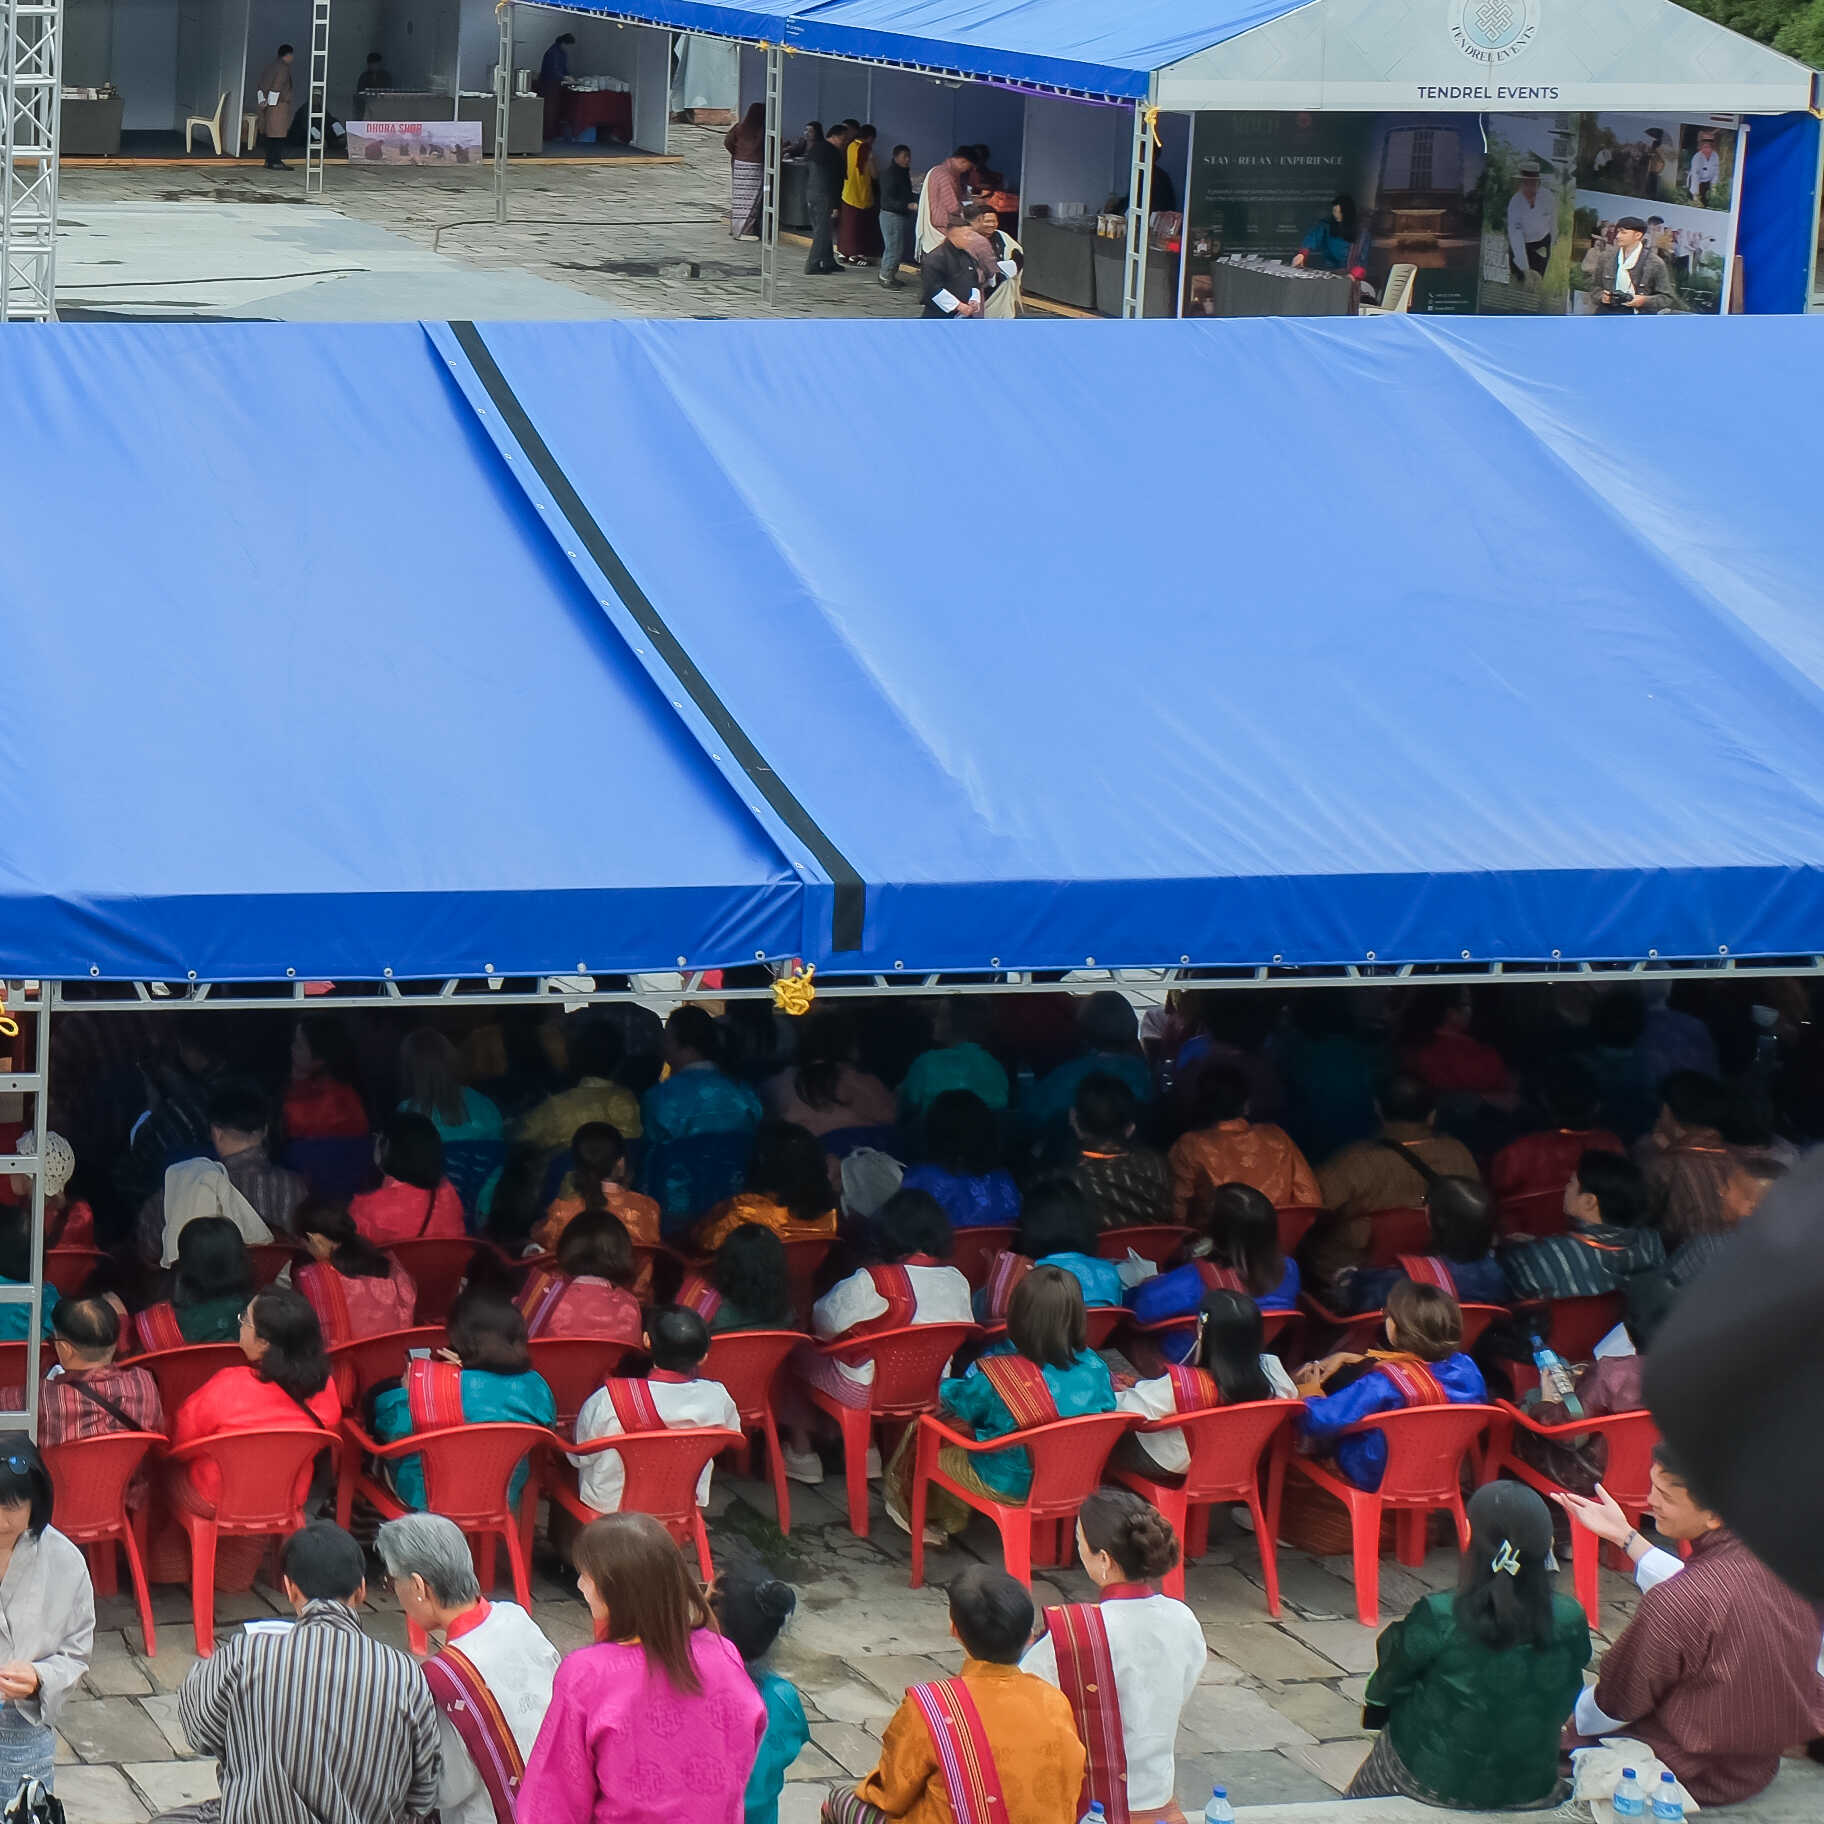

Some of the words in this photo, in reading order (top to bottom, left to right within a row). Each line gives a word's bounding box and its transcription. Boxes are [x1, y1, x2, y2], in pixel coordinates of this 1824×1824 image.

[1451, 25, 1495, 63] TENDREL
[1497, 25, 1535, 62] EVENTS
[1417, 86, 1492, 99] TENDREL
[1497, 86, 1559, 99] EVENTS
[1203, 155, 1230, 166] STAY
[1237, 155, 1273, 166] RELAX
[1280, 155, 1344, 166] EXPERIENCE
